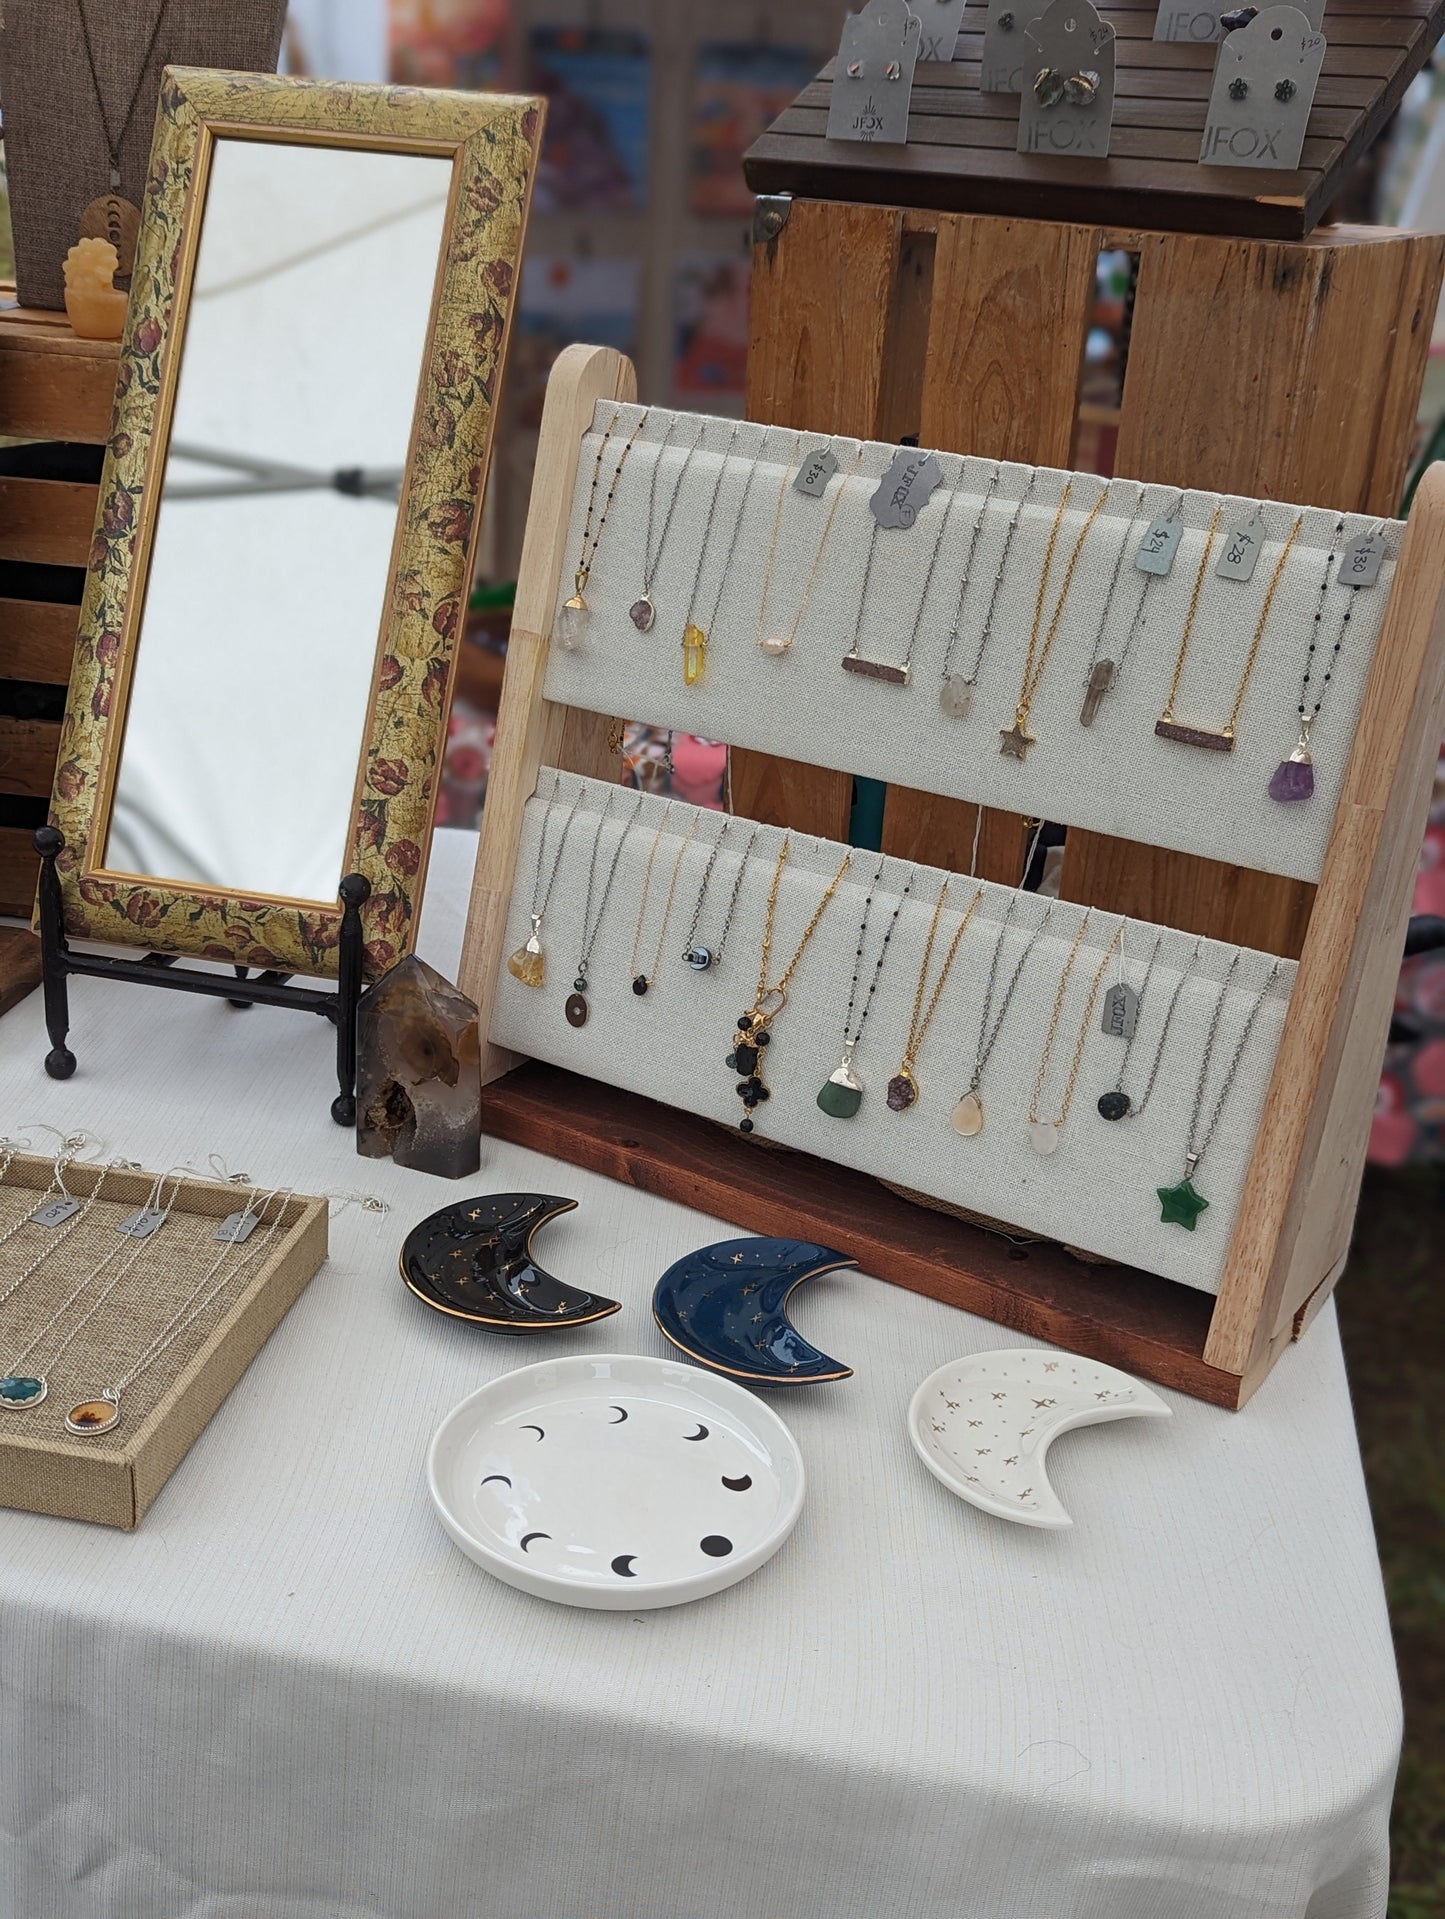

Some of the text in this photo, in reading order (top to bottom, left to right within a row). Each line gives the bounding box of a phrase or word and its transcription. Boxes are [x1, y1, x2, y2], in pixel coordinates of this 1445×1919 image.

[1166, 12, 1220, 41] JFO
[1301, 37, 1321, 51] $20
[1200, 126, 1282, 160] JFOX
[805, 463, 827, 485] $30
[1141, 528, 1171, 554] $24
[1227, 531, 1254, 564] $28
[1352, 547, 1376, 573] $30
